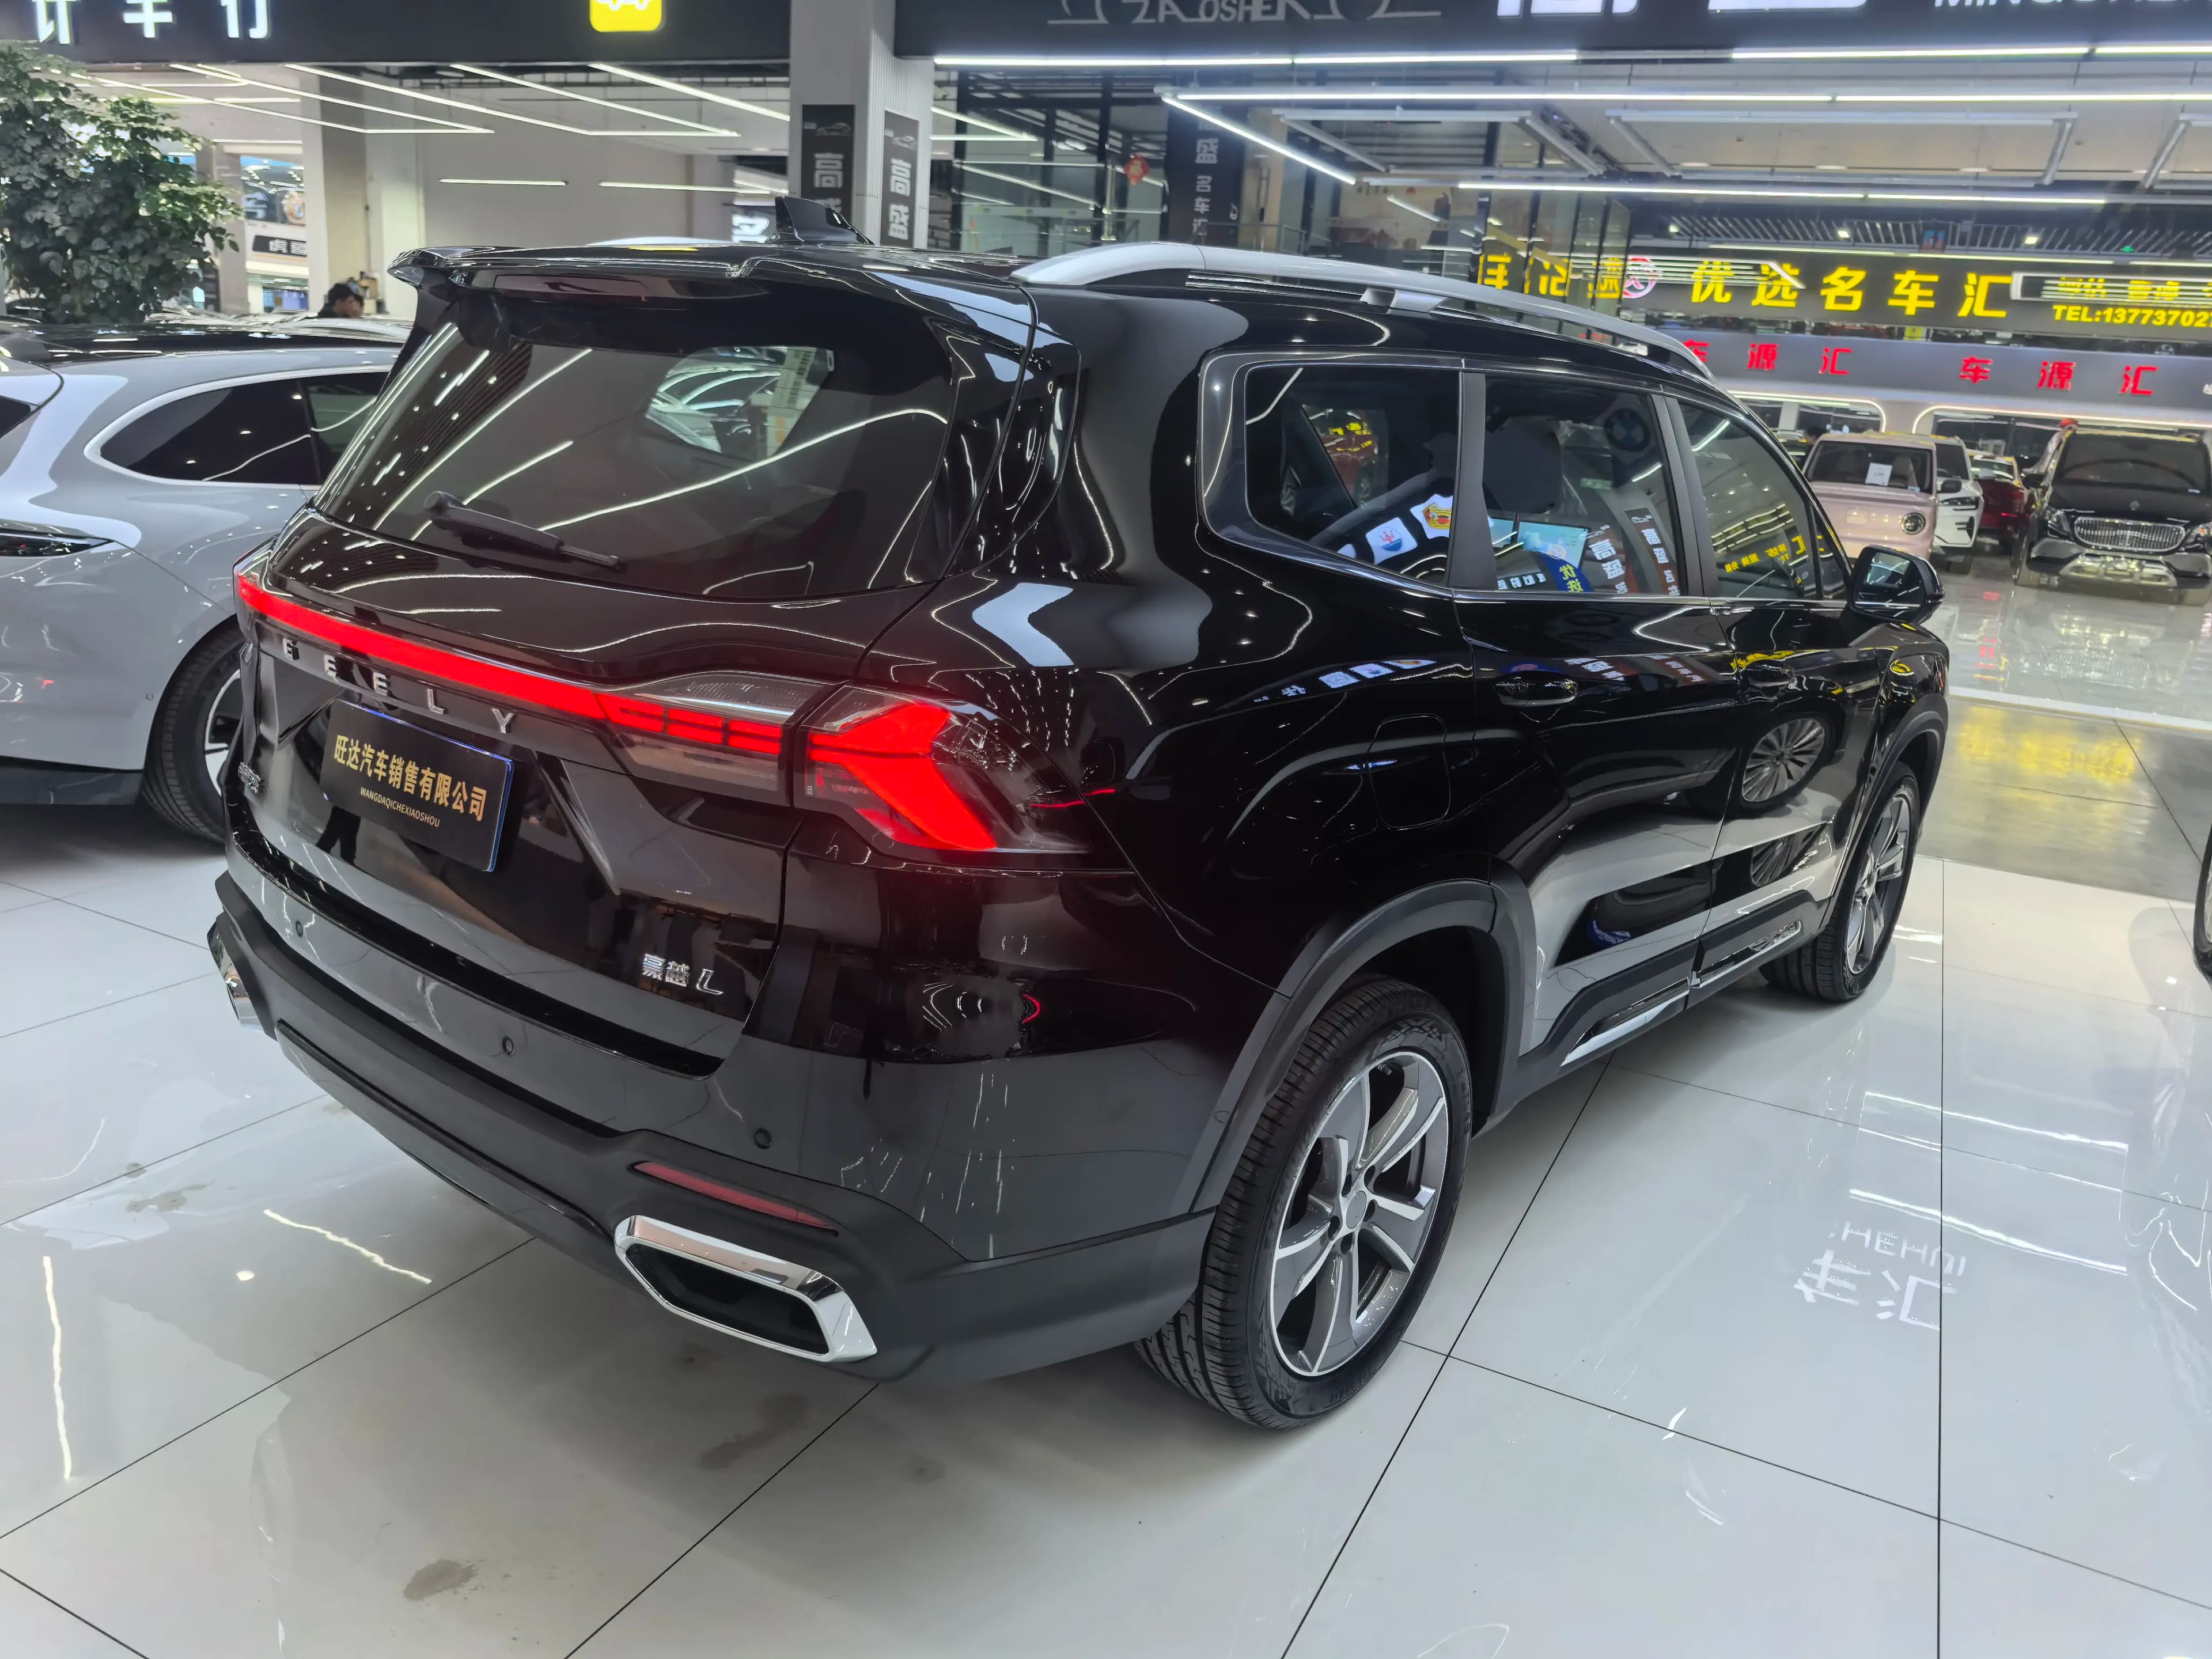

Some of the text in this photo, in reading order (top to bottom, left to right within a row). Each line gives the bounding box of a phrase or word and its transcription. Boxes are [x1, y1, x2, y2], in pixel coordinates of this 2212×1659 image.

[1691, 260, 2013, 318] 优选名车汇
[2052, 304, 2212, 328] TEL:13773702
[1959, 356, 2159, 396] 车源汇
[282, 638, 517, 734] GEELY
[334, 734, 488, 822] 旺达汽车销售有限公司
[359, 786, 441, 828] WANGDAQICHEXIAOSHOU
